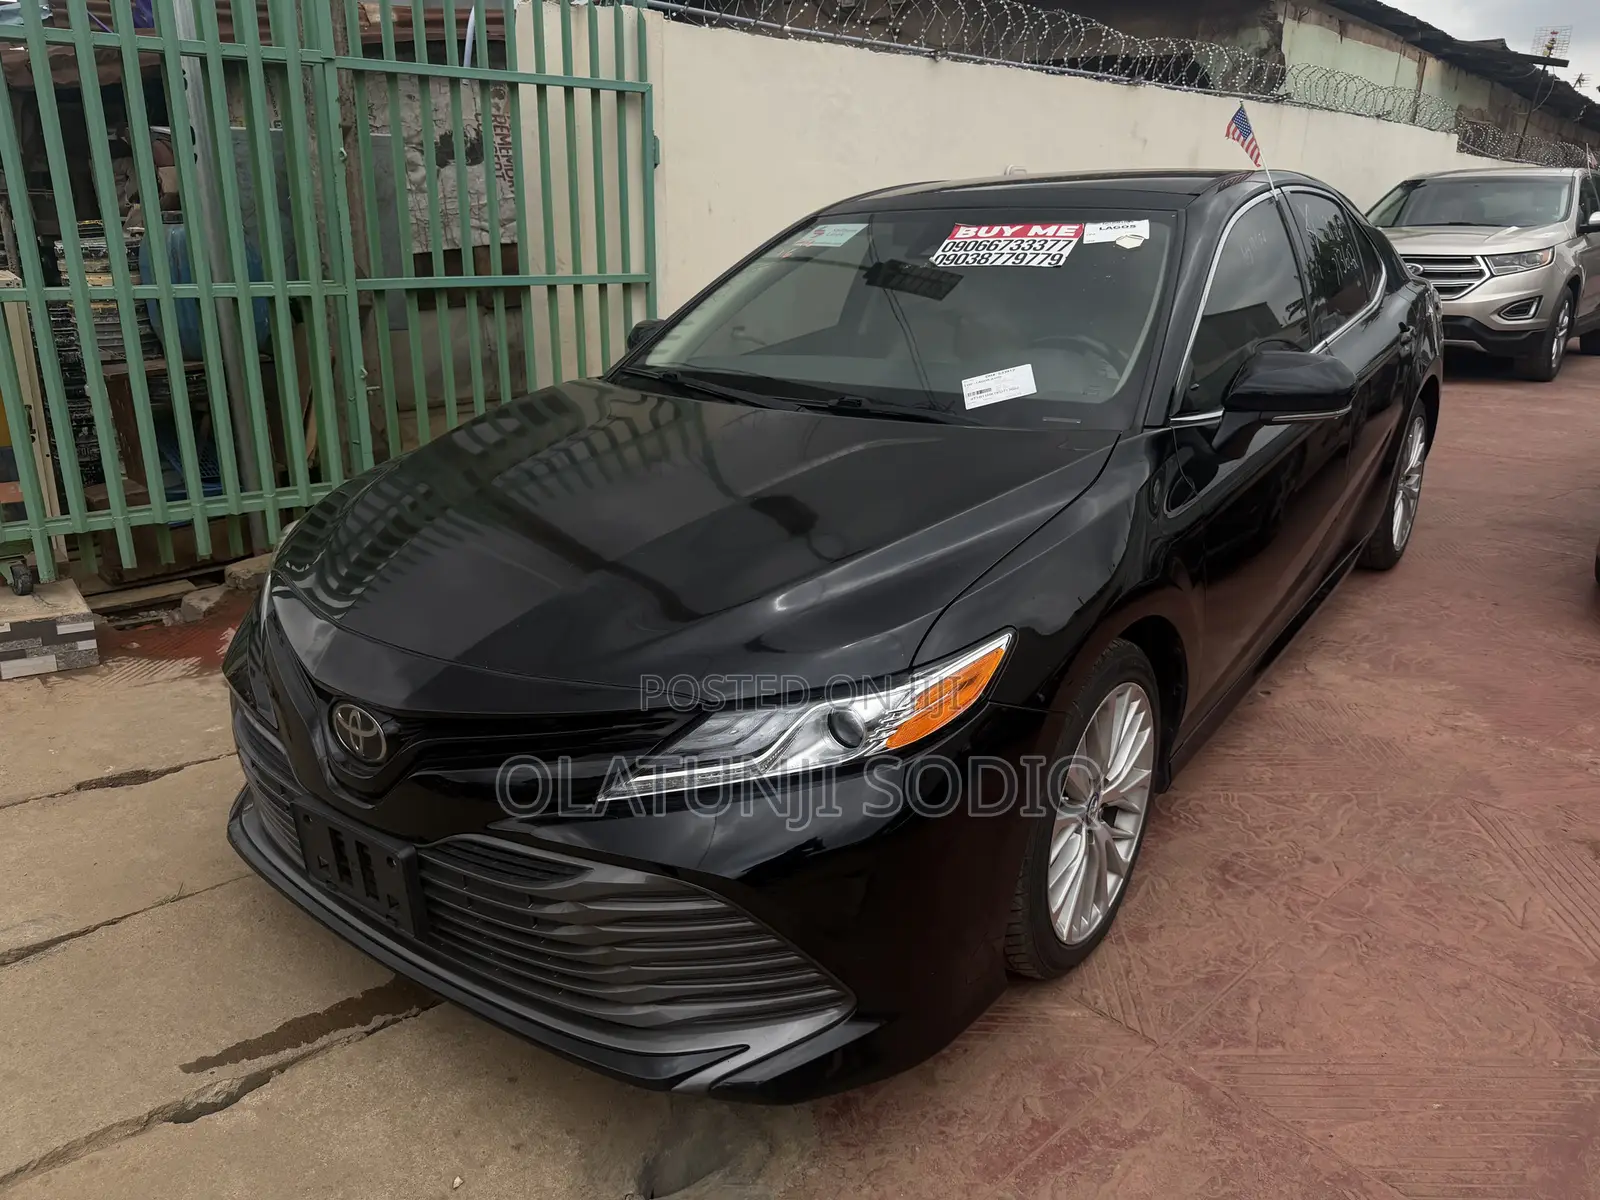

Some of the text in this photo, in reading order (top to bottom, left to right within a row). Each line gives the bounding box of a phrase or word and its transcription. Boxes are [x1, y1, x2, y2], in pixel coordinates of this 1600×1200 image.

[954, 225, 1079, 238] BUY ME
[941, 239, 1073, 253] 09066733377
[934, 253, 1064, 266] 09038779779
